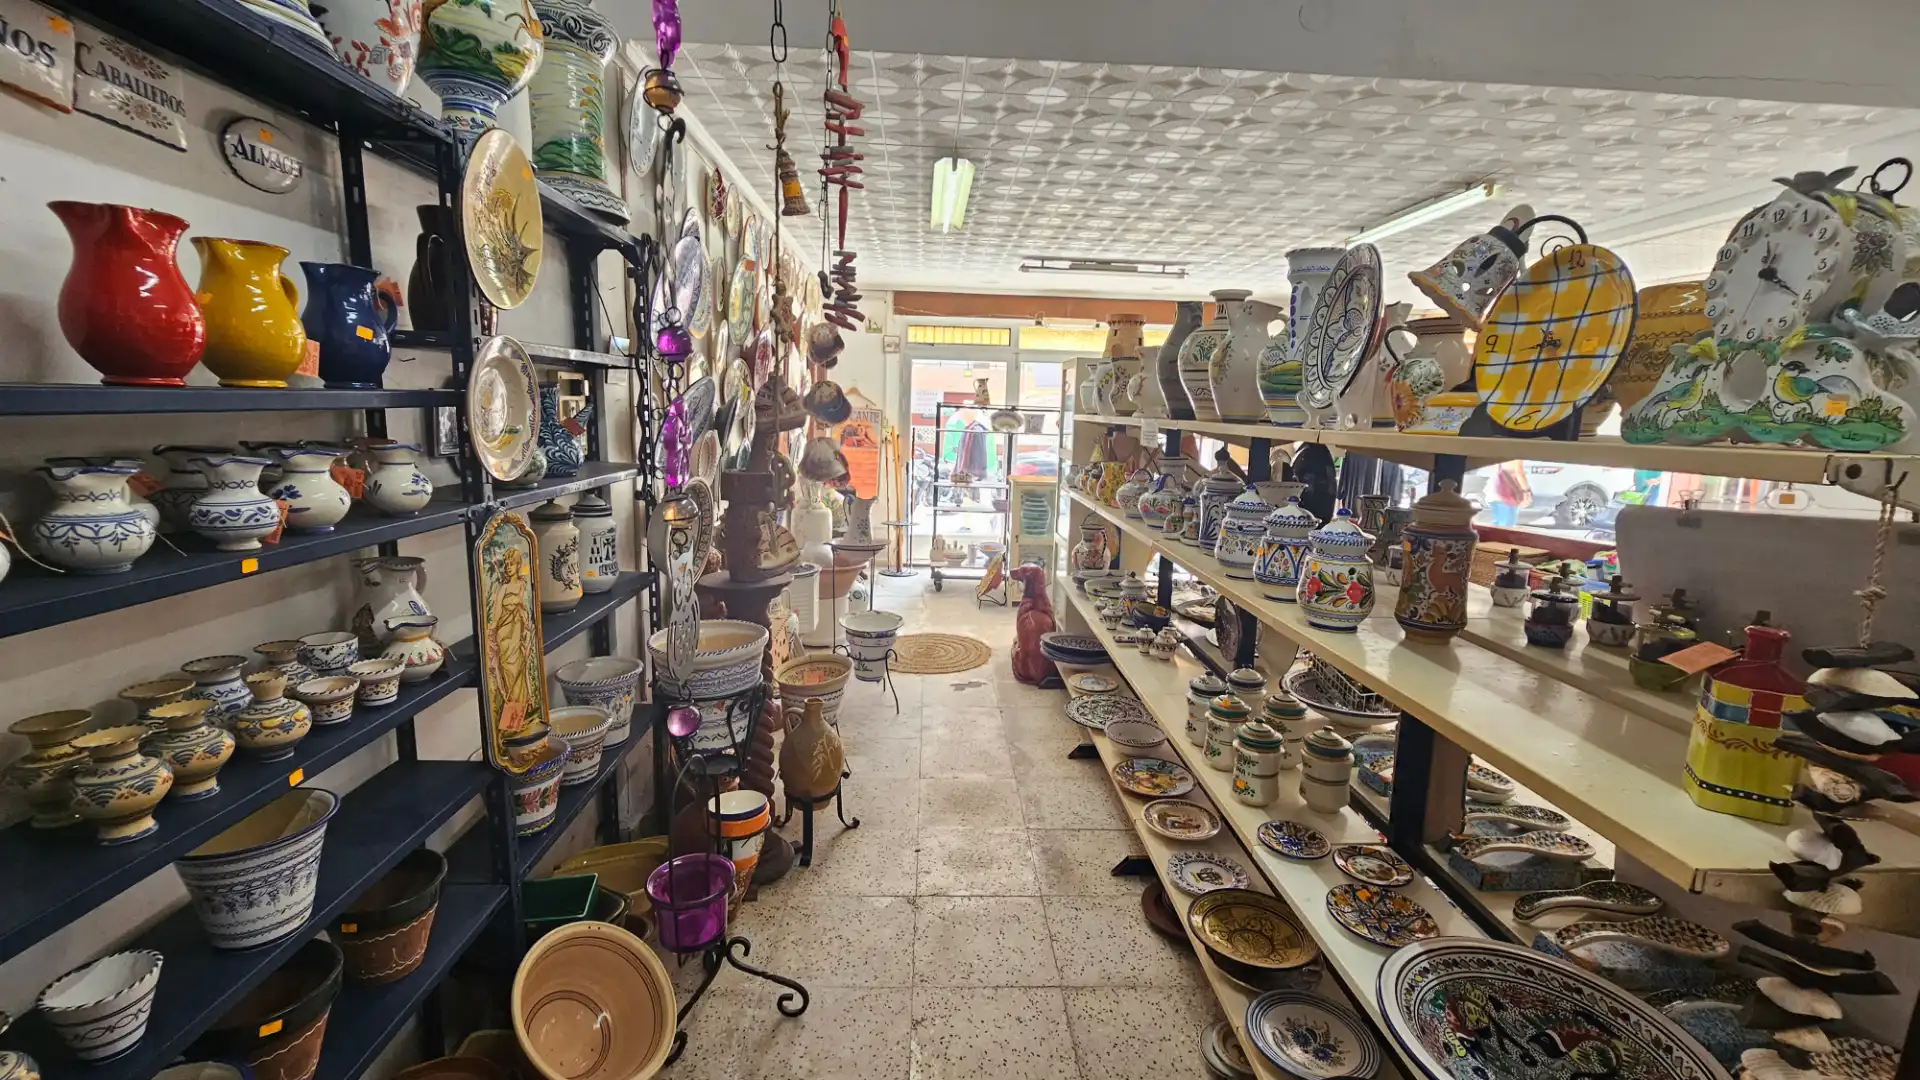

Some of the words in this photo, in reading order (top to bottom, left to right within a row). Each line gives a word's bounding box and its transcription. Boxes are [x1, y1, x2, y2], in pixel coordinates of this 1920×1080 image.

[74, 41, 187, 118] CABALLEROS
[1773, 208, 1786, 223] 12
[1801, 208, 1809, 224] 1
[1742, 222, 1756, 238] 11
[1817, 227, 1829, 241] 2
[1567, 250, 1585, 270] 12
[1719, 248, 1732, 262] 10
[1817, 257, 1828, 272] 3
[1707, 278, 1717, 291] 9
[1802, 288, 1813, 302] 4
[1707, 304, 1717, 317] 8
[1778, 315, 1789, 329] 5
[1719, 323, 1729, 336] 7
[1745, 327, 1757, 340] 6
[1485, 334, 1500, 354] 9
[1513, 409, 1542, 427] 6
